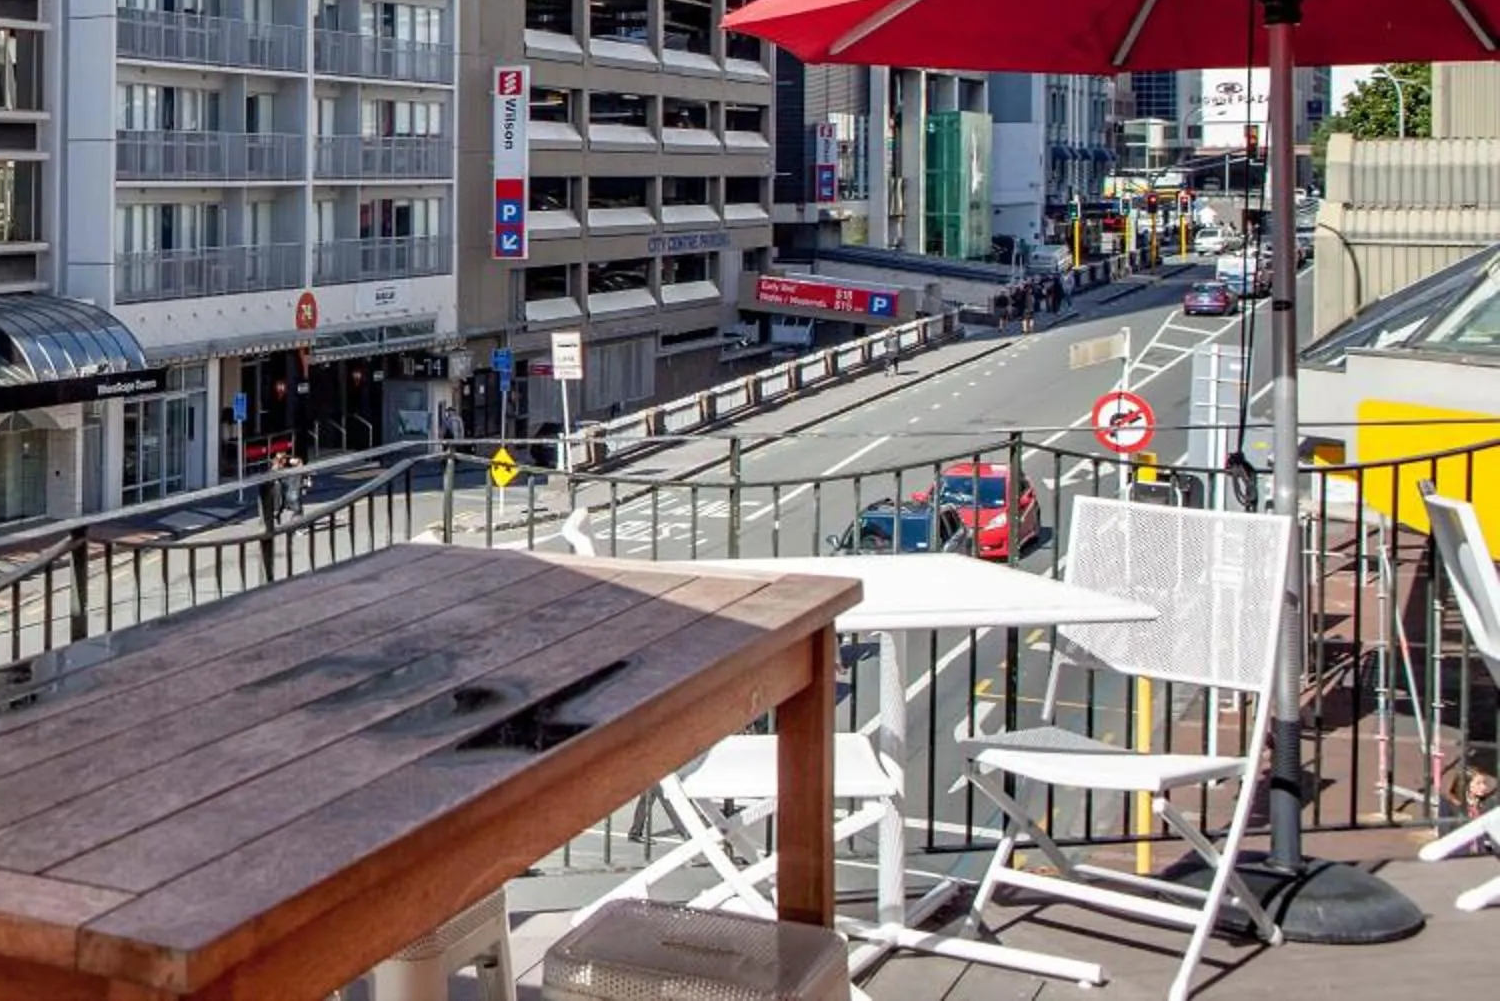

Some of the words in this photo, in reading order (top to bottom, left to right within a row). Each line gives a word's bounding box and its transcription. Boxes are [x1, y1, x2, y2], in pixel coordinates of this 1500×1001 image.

[504, 98, 517, 150] Wilson
[503, 204, 517, 221] P
[872, 297, 888, 312] P
